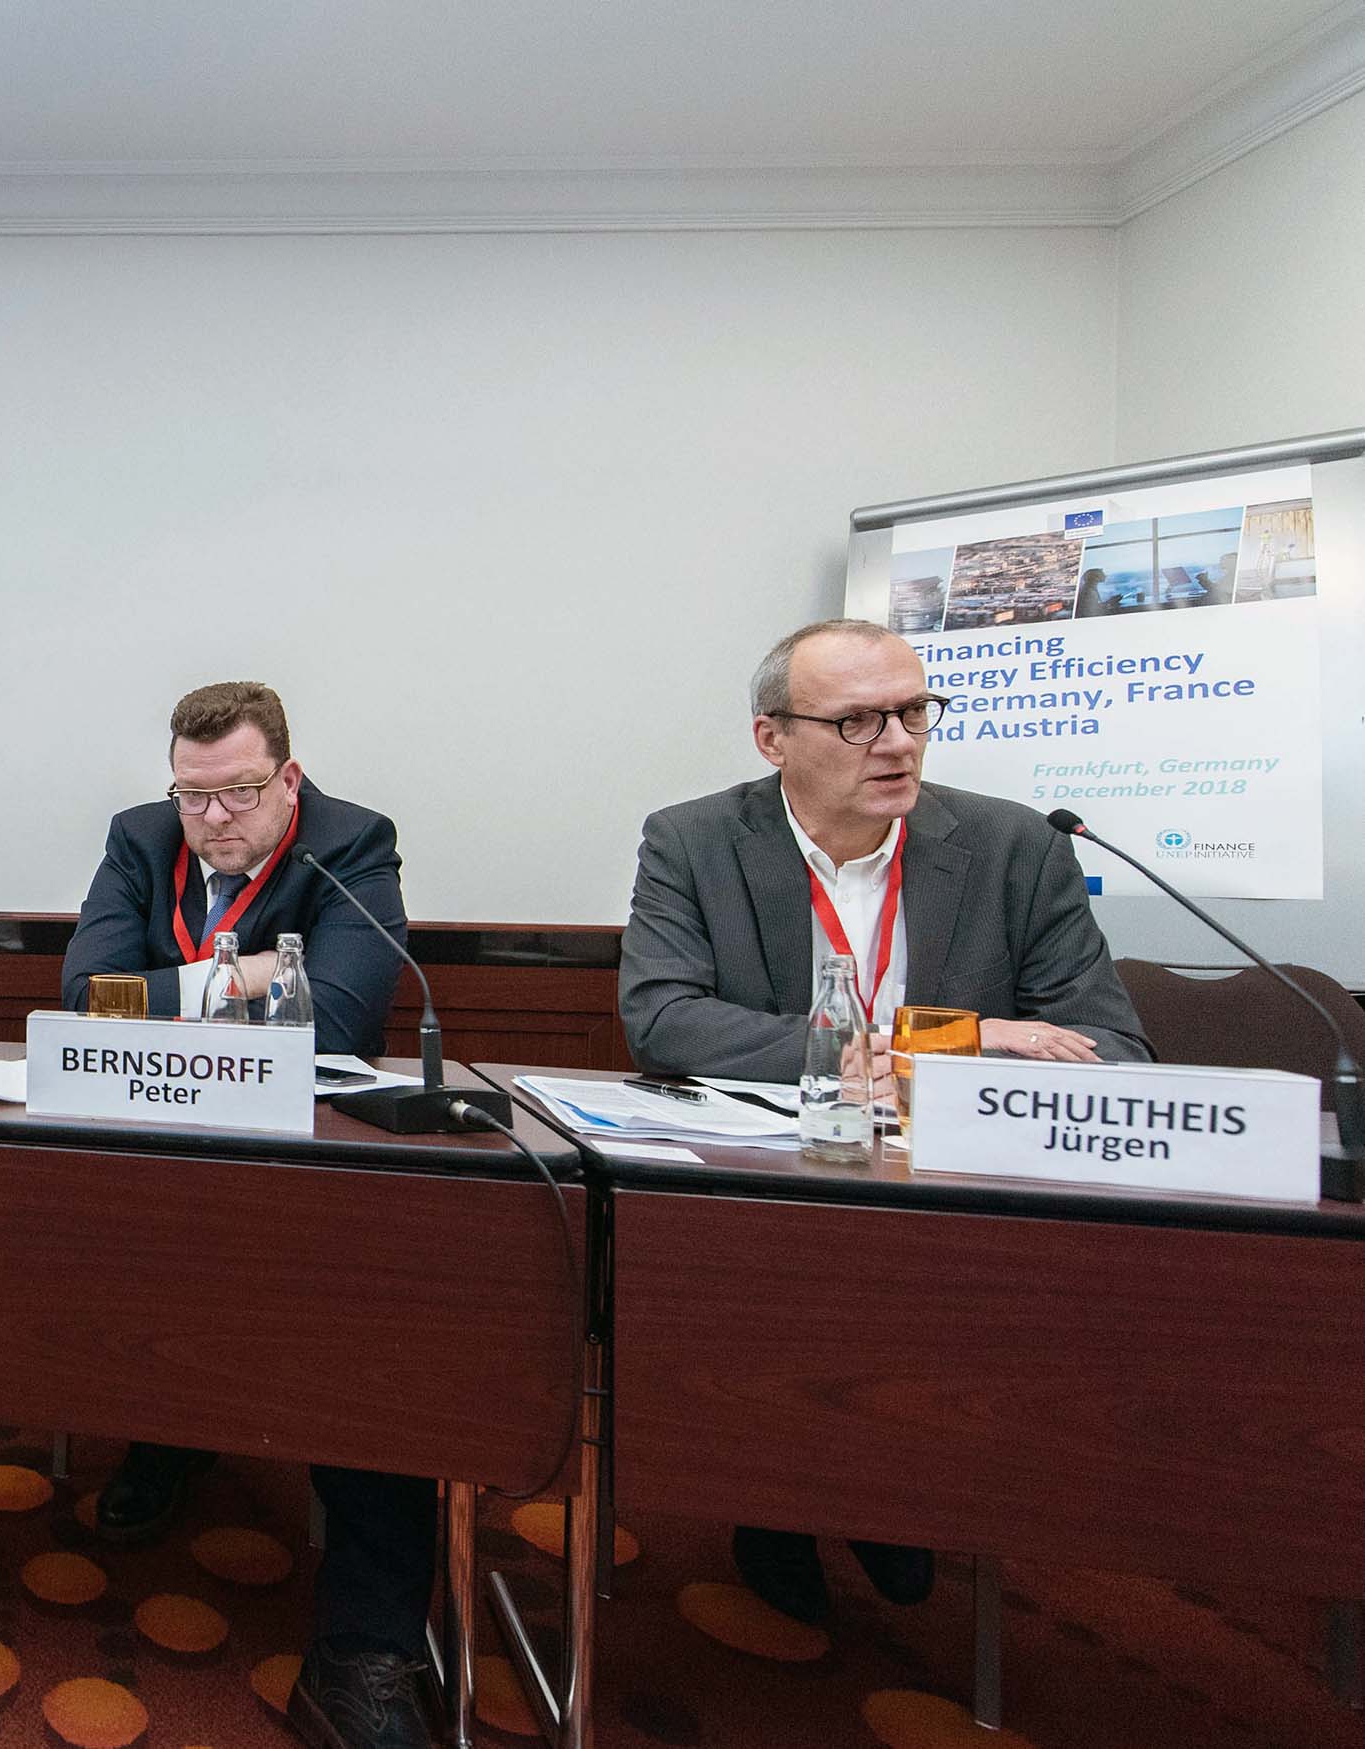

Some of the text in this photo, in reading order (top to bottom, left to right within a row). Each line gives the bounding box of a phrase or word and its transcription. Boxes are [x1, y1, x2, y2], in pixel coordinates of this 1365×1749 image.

[912, 636, 1065, 663] Financing
[928, 651, 1204, 689] nergy Efficiency
[1128, 678, 1256, 703] France
[928, 714, 1099, 743] nd Austria
[1033, 755, 1279, 779] Frankfurt, Germany
[1033, 778, 1247, 800] 5 December 2018
[1194, 843, 1255, 851] FINANCE
[62, 1047, 273, 1084] BERNSDORFF
[129, 1079, 201, 1105] Peter
[977, 1086, 1247, 1136] SCHULTHEIS
[1044, 1125, 1171, 1161] Jürgen
